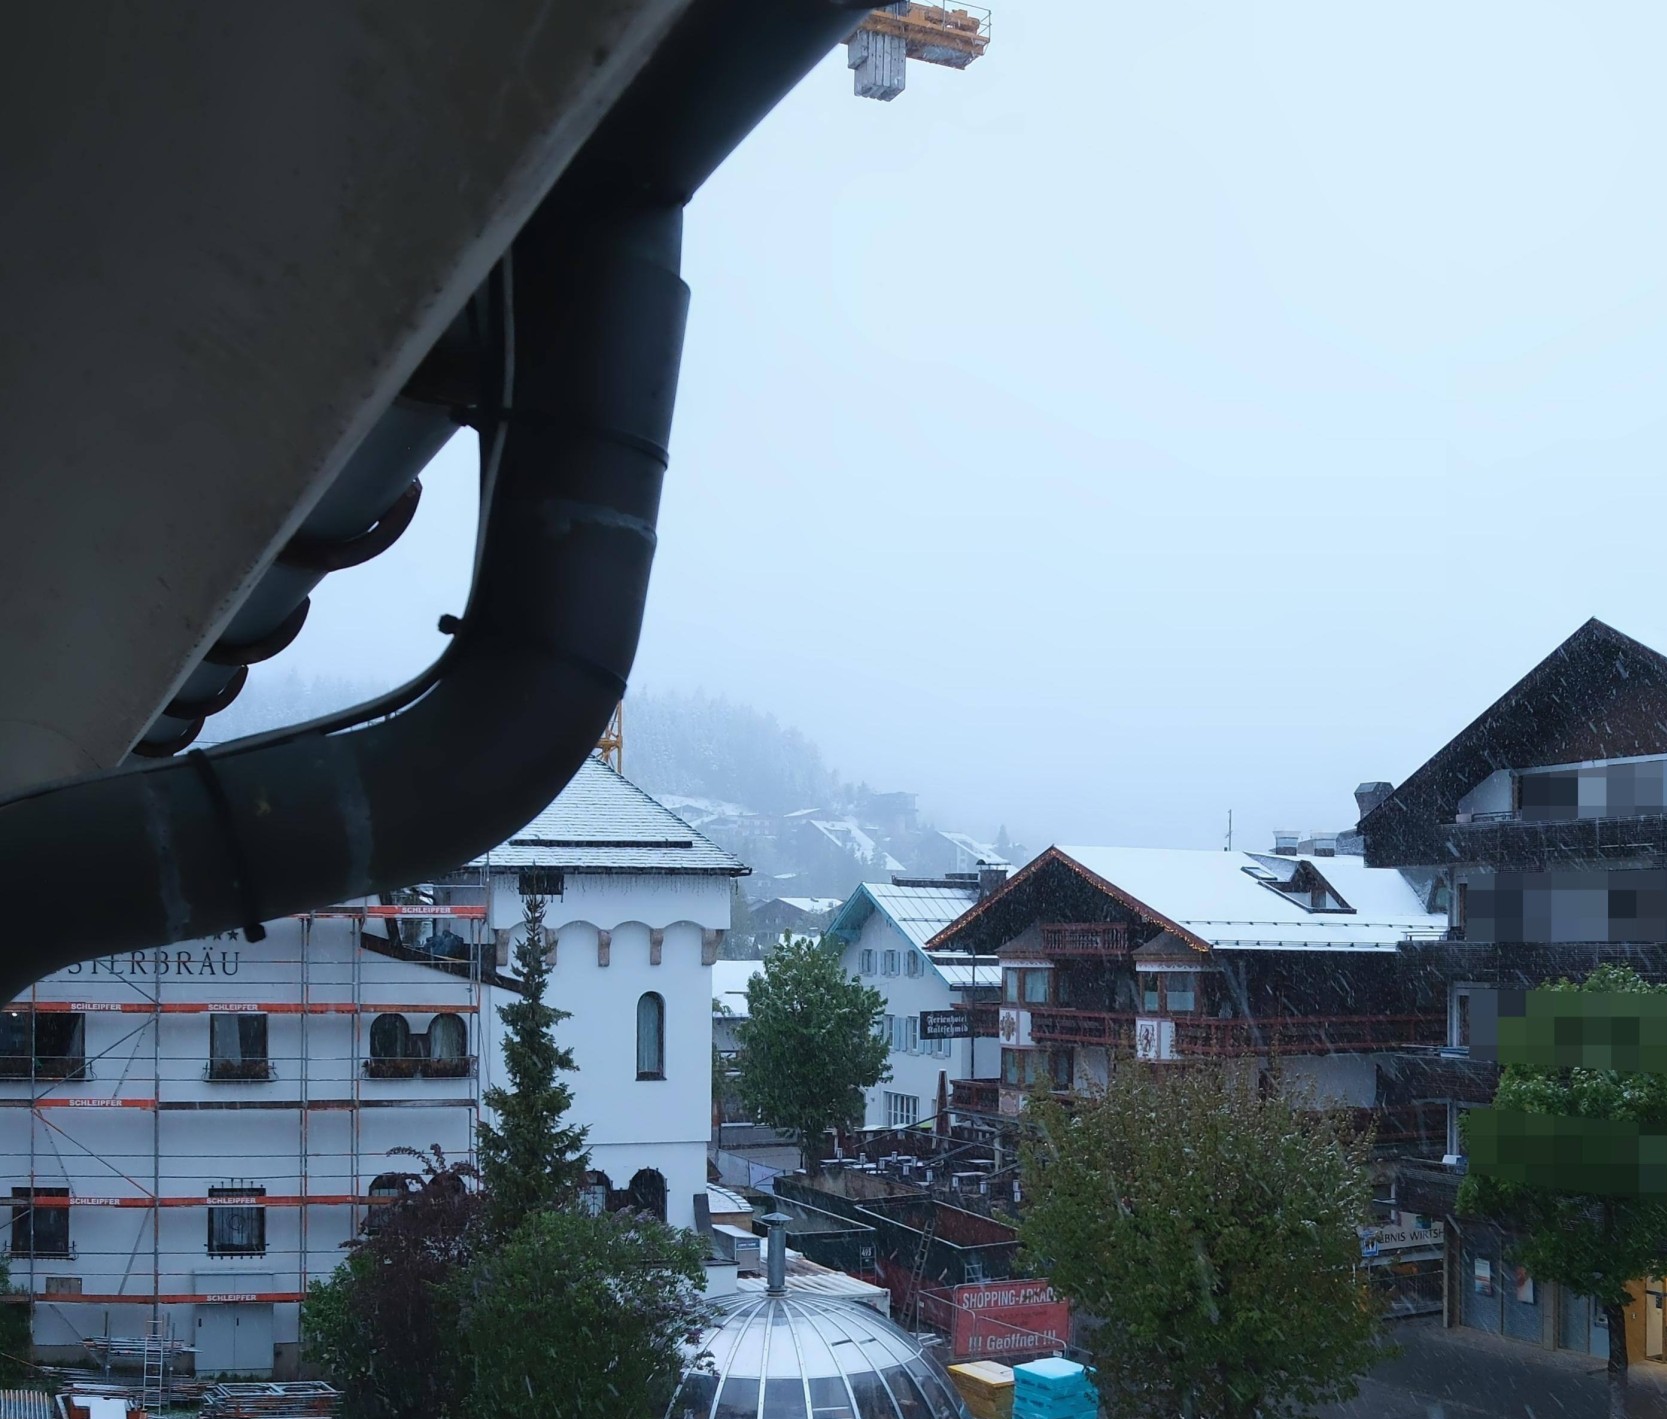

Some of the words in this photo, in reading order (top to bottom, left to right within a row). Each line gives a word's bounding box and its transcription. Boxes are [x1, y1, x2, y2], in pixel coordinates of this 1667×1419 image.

[402, 906, 451, 915] SCHLEIPFER
[71, 1003, 122, 1011] SCHLEIPFER
[207, 1003, 258, 1011] SCHLEIPFER
[69, 1099, 122, 1107] SCHLEIPFER
[206, 1197, 257, 1205] SCHLEIPFER
[206, 1294, 257, 1302] SCHLEIPFER
[987, 1333, 1039, 1351] Geöffnet
